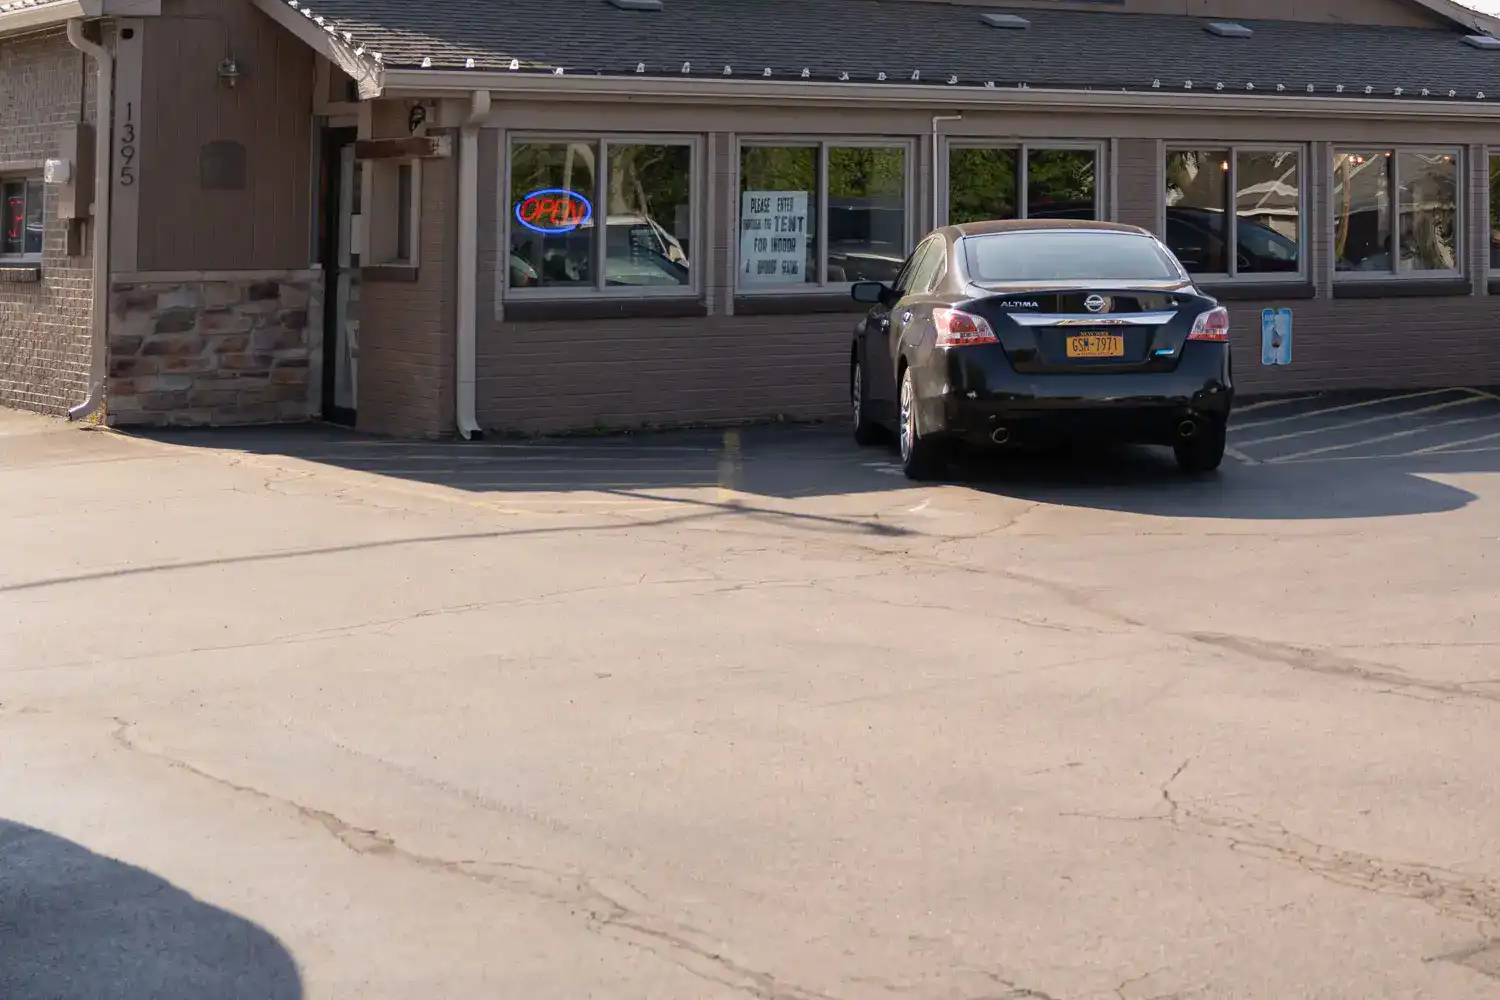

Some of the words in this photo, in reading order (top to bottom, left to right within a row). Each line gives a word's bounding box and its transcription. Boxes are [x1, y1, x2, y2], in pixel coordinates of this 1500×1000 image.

[120, 102, 135, 186] 1395
[520, 197, 587, 225] OPEN
[750, 197, 771, 213] PLEASE
[777, 197, 794, 212] ENTER
[774, 215, 805, 232] TENT
[754, 237, 768, 253] FOR
